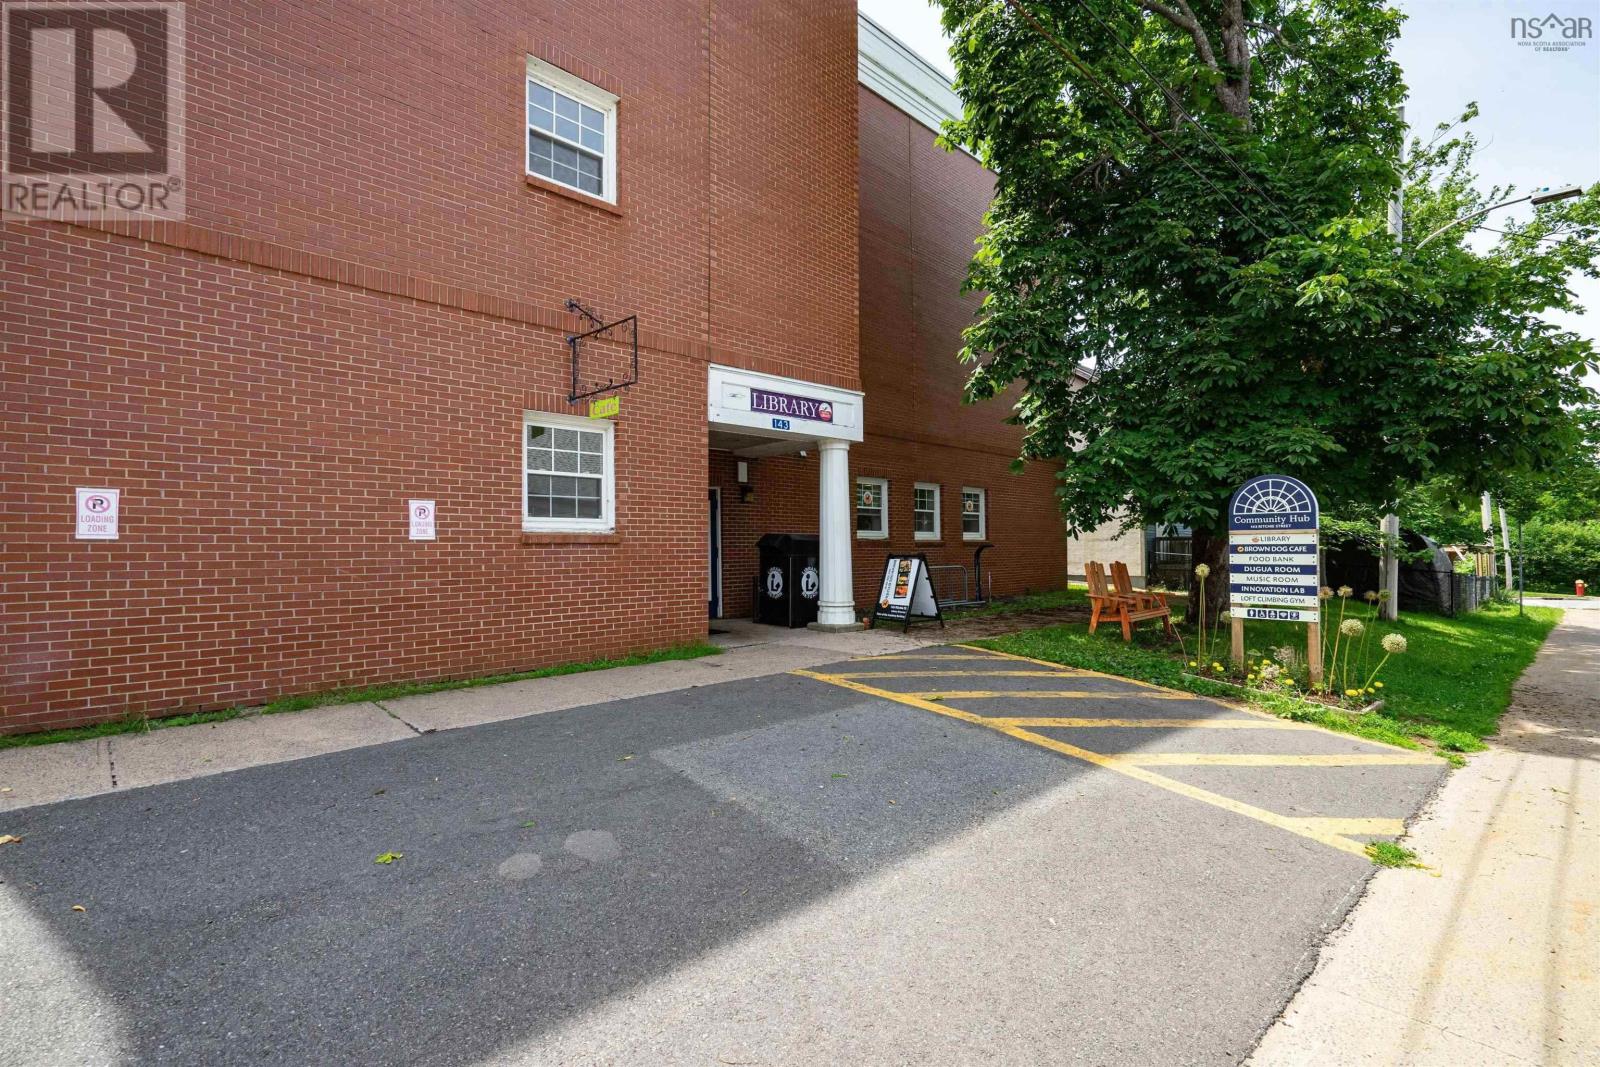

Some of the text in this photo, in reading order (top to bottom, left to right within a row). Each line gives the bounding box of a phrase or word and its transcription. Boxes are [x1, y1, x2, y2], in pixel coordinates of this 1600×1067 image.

[752, 392, 819, 417] LIBRARY
[773, 419, 789, 429] 143
[80, 515, 114, 523] LOADING
[1234, 515, 1286, 524] Community
[1241, 585, 1305, 594] INNOVATION LAB
